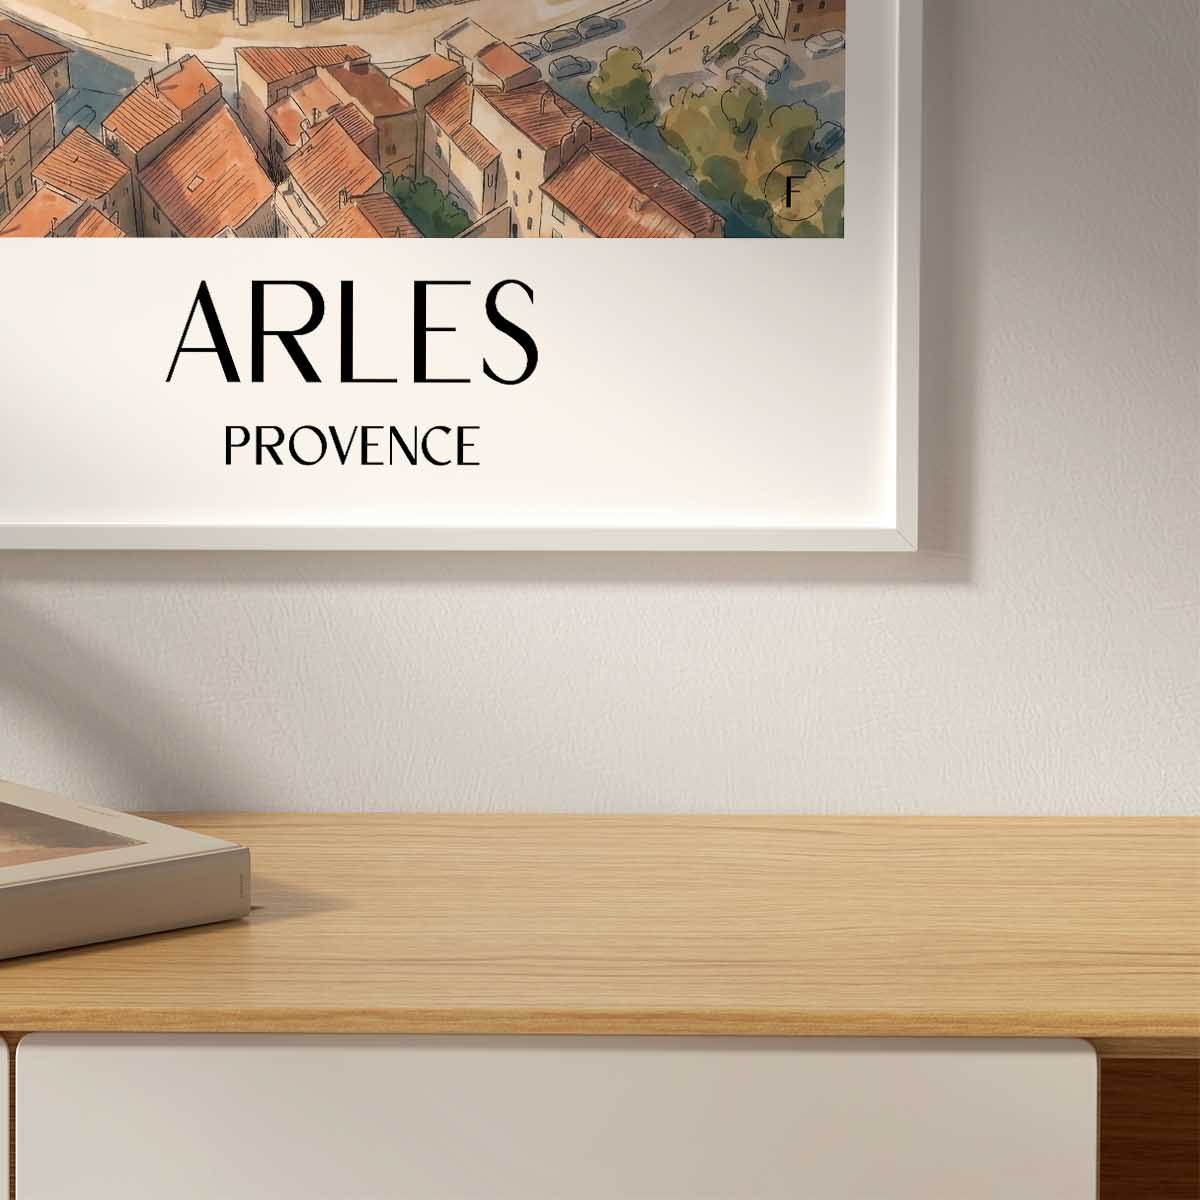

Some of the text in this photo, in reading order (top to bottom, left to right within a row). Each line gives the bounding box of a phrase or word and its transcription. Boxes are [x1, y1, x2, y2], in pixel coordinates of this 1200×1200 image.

[785, 175, 808, 208] F
[165, 279, 538, 385] ARLES
[225, 425, 481, 466] PROVENCE
